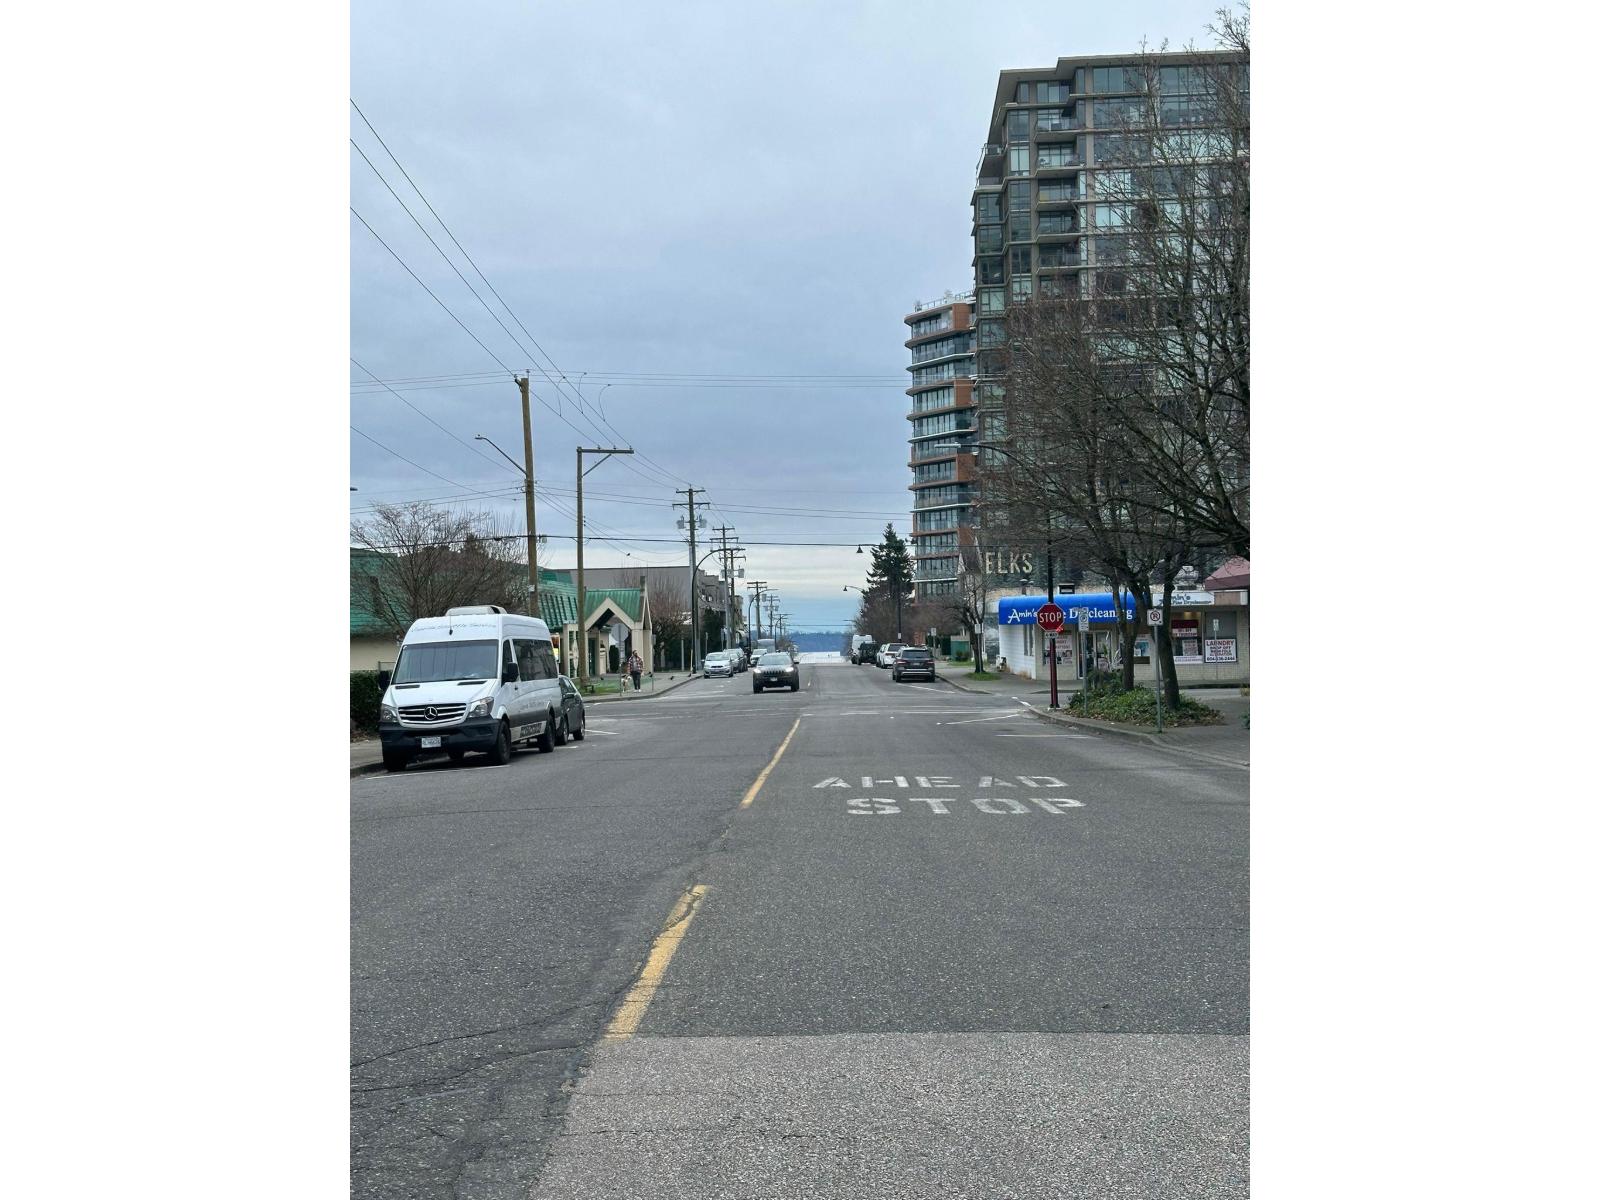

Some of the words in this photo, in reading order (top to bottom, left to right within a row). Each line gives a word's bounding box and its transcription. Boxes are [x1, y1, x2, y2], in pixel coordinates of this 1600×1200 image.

[985, 551, 1032, 574] ELKS
[1007, 608, 1037, 623] Amin's
[1069, 607, 1133, 619] Dcleang
[1039, 612, 1062, 624] STOP
[812, 776, 1069, 788] AHEAD
[846, 797, 1087, 815] STOP
